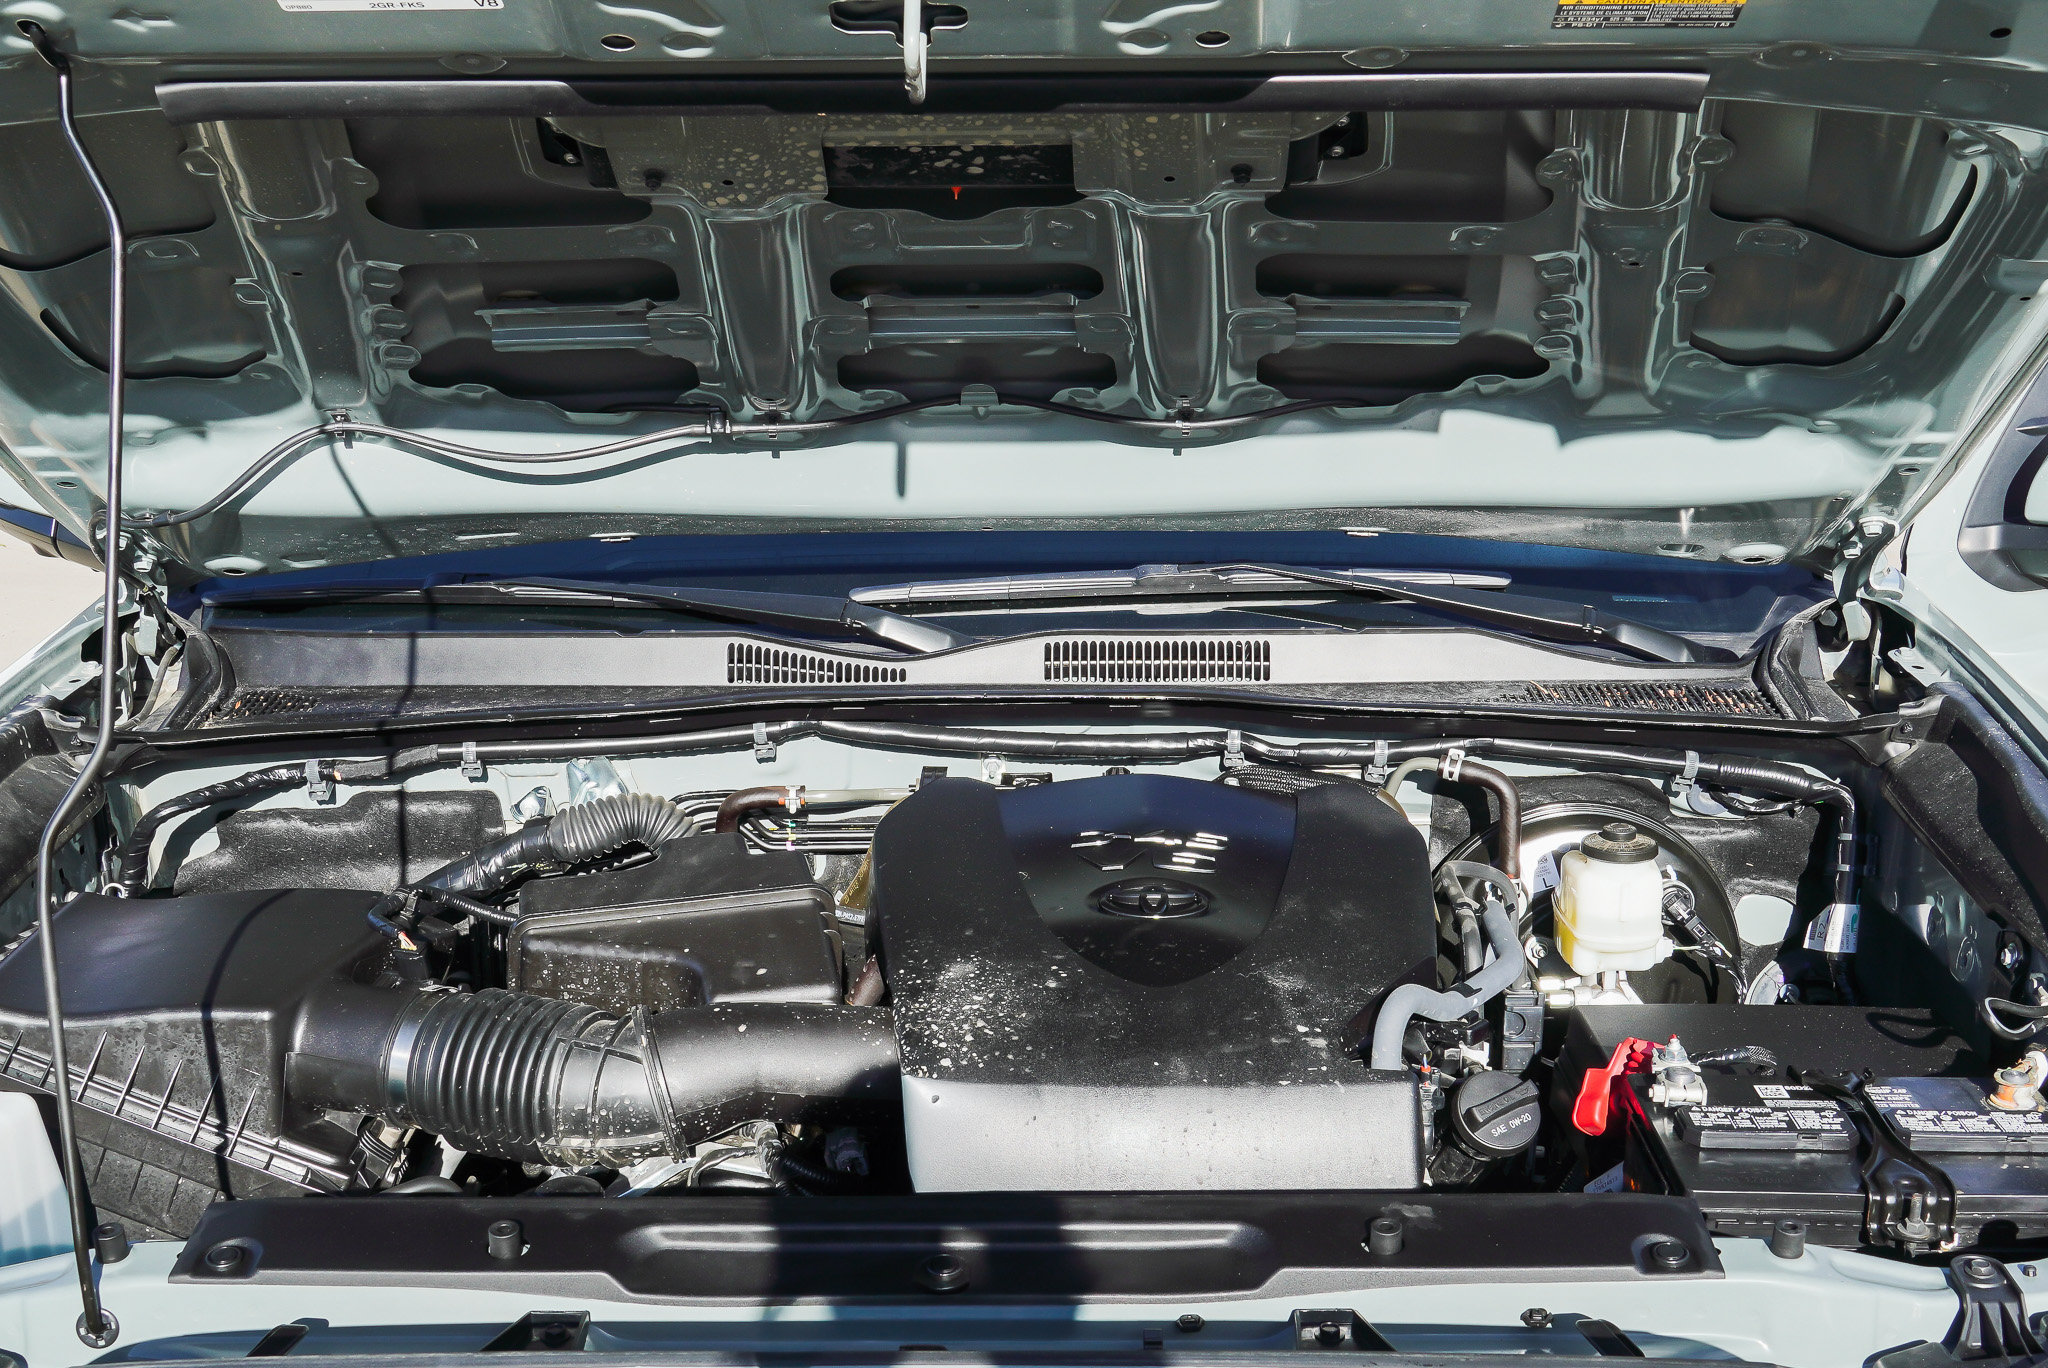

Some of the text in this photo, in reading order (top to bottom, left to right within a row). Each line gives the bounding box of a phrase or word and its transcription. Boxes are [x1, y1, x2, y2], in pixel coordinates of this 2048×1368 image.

[1542, 877, 1554, 888] L
[1491, 1113, 1532, 1137] SAE 0W-20
